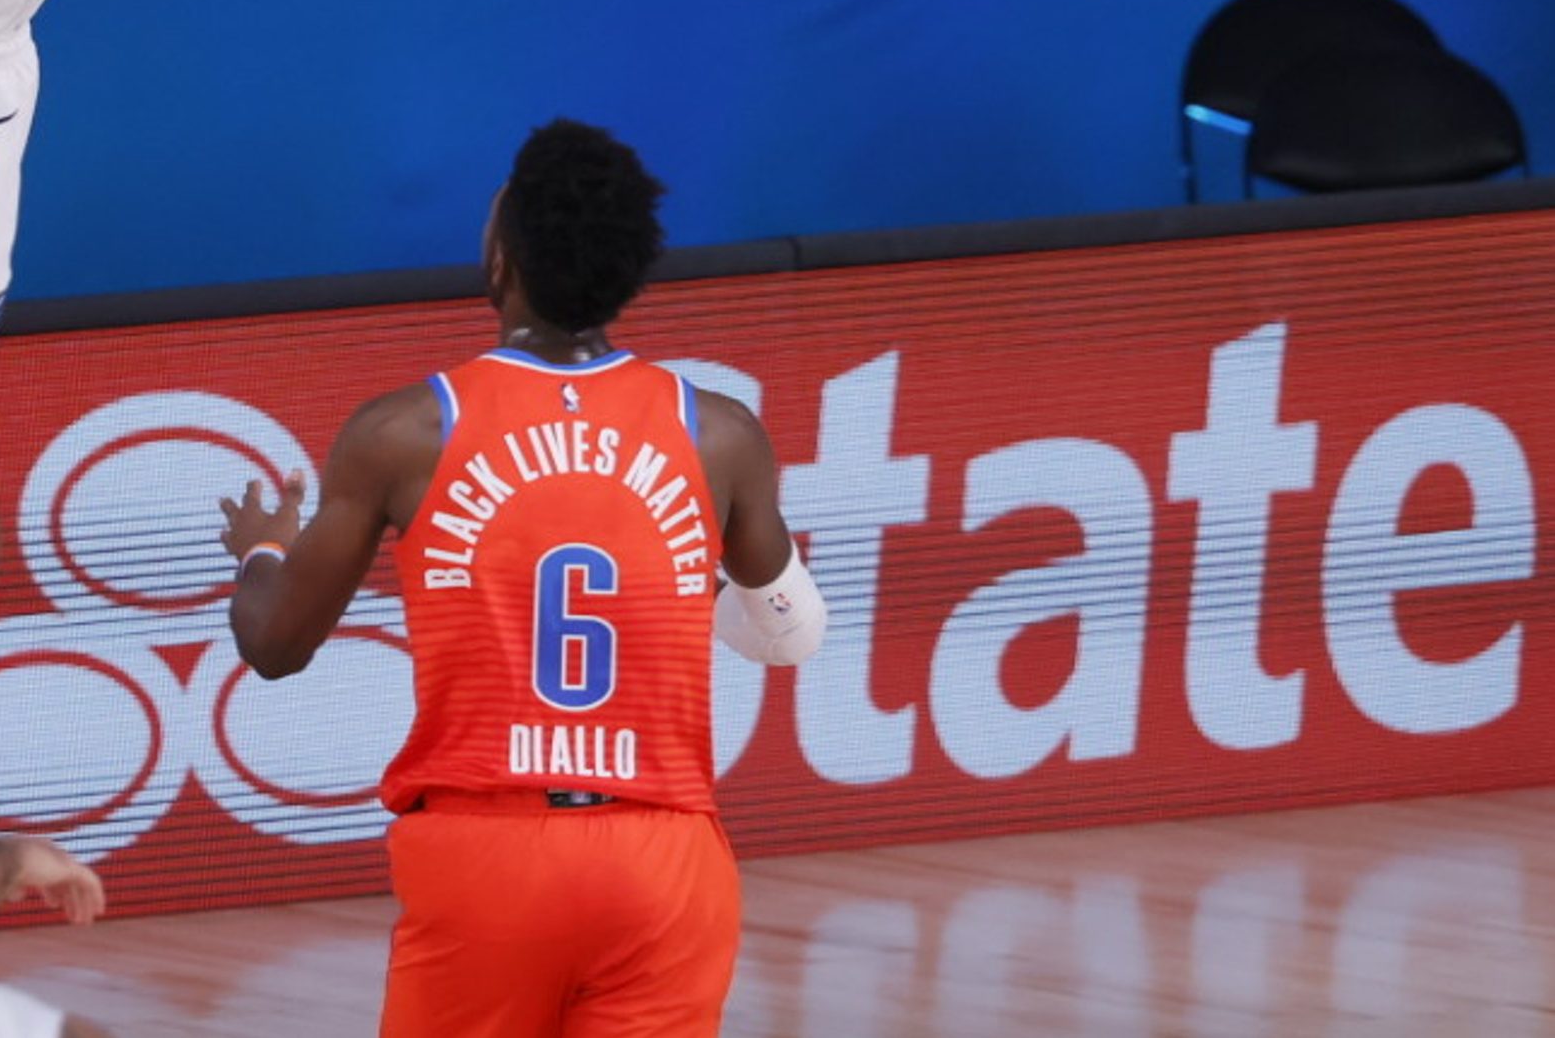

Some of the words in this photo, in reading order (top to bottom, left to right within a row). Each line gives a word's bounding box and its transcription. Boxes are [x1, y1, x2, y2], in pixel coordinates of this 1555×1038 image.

[423, 452, 517, 590] BLACK
[504, 420, 620, 483] LIVES
[623, 441, 708, 596] MATTER
[531, 542, 619, 713] 6
[509, 723, 638, 781] DIALLO
